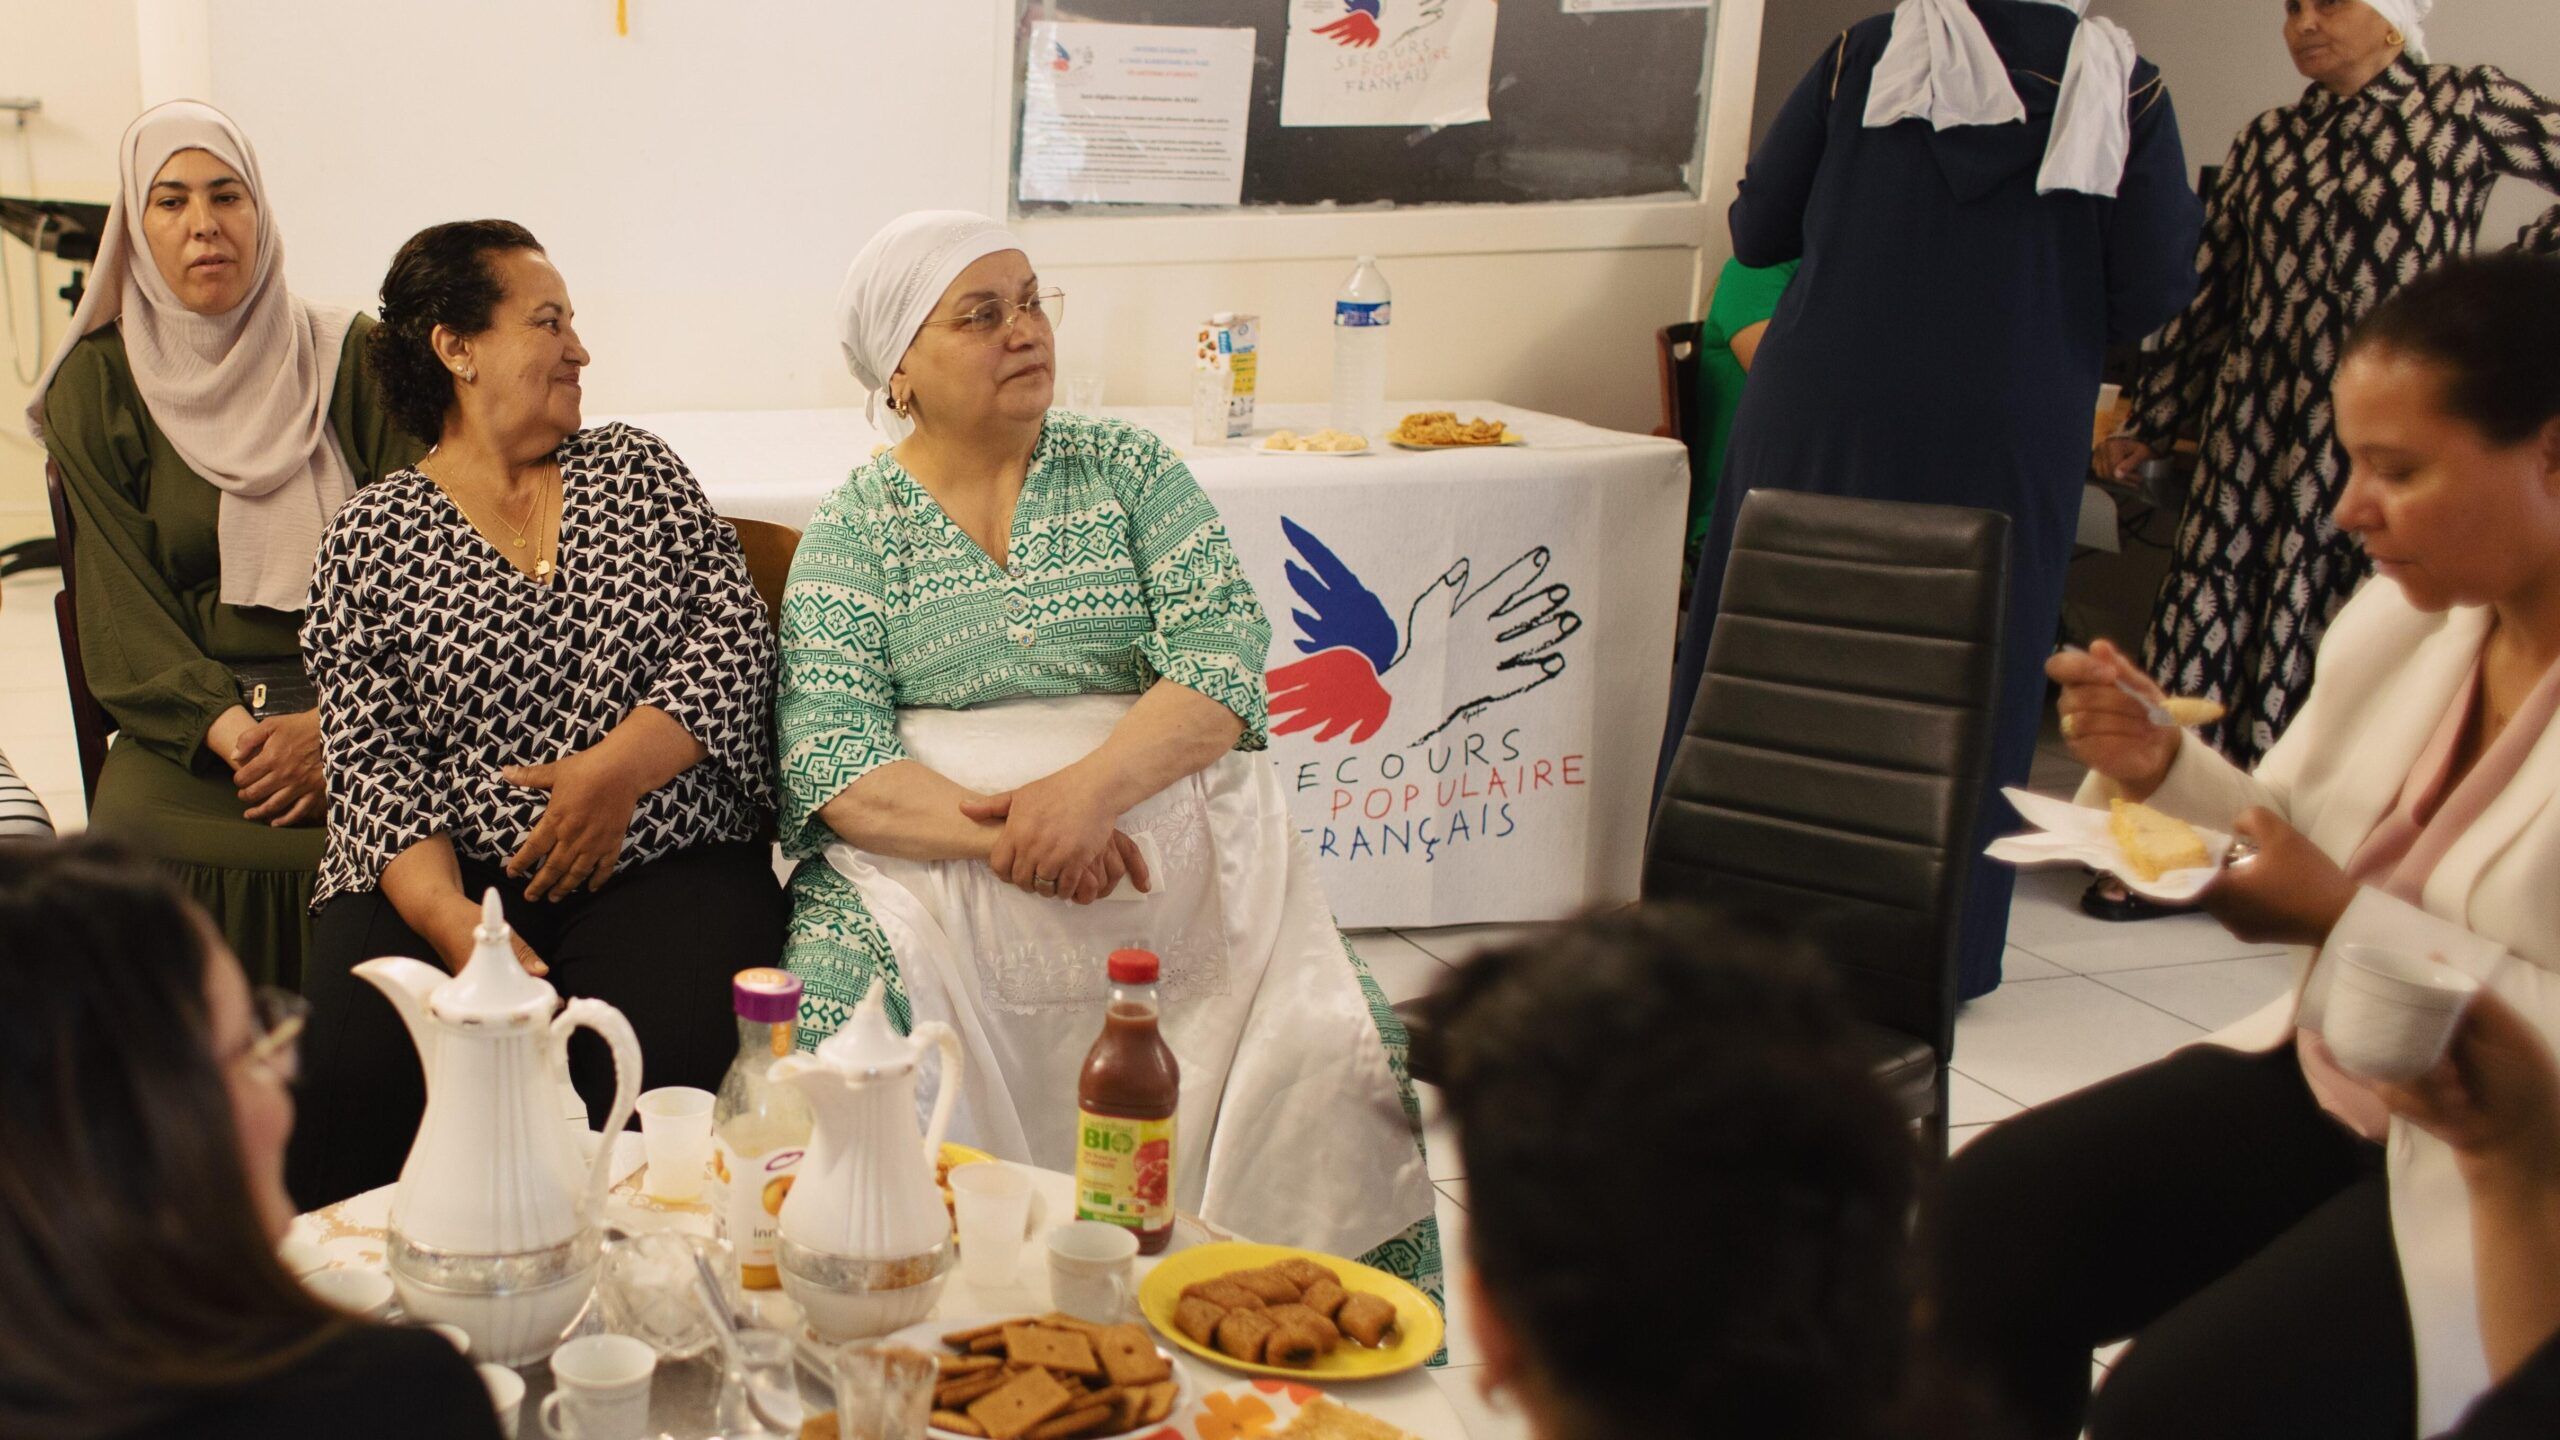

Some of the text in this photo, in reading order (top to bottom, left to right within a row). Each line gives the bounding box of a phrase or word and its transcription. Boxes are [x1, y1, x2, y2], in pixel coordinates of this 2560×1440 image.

[1334, 38, 1430, 71] SECOURS
[1361, 46, 1451, 76] POPULAIRE
[1344, 67, 1429, 92] FRANÇAIS
[1274, 728, 1520, 792] ECOURS
[1331, 755, 1585, 820] POPULAIRE
[1300, 803, 1514, 862] RANÇAIS
[1084, 1127, 1133, 1154] BIO
